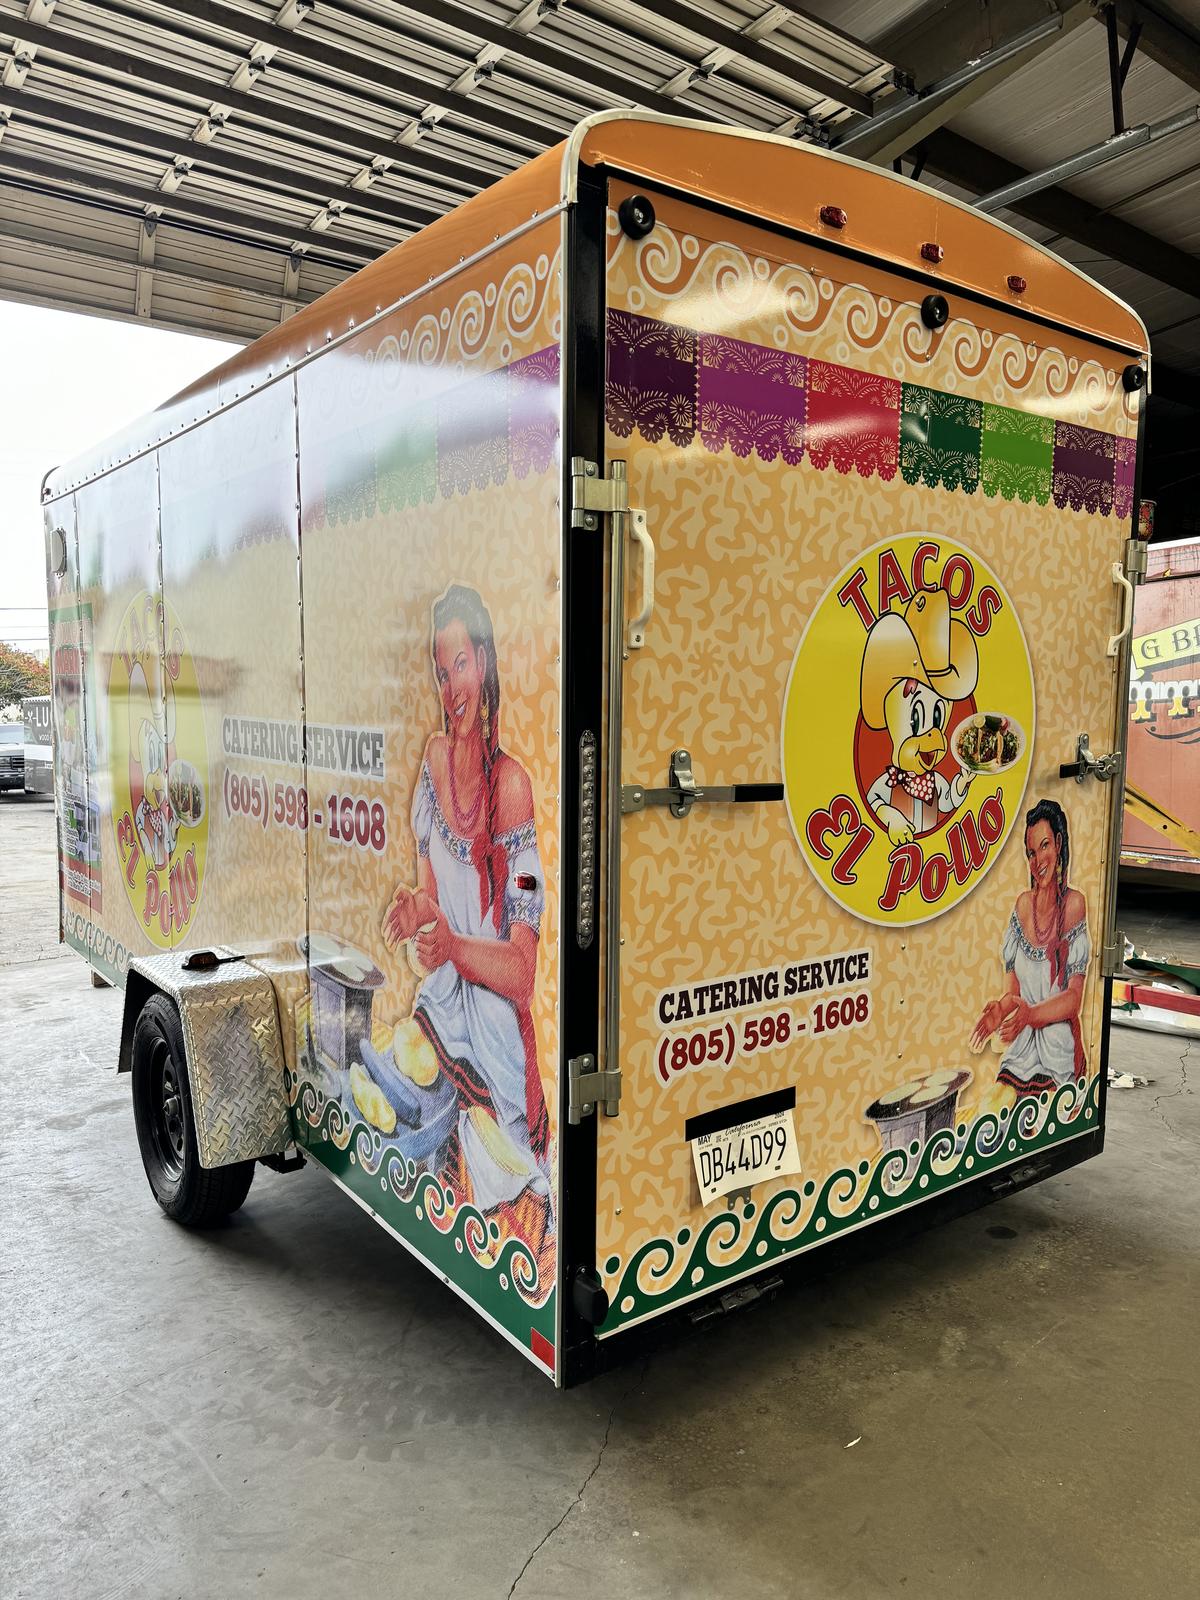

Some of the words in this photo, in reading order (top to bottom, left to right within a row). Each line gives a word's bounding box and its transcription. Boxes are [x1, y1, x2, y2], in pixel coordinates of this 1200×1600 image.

[837, 541, 1003, 638] TACOS
[222, 717, 298, 764] CATERING
[303, 725, 385, 778] SERVICE
[223, 767, 269, 830] (805)
[273, 783, 309, 831] 598
[327, 794, 387, 851] 1608
[806, 794, 875, 886] El
[877, 787, 1005, 912] Pollo
[143, 842, 199, 937] Pollo
[658, 969, 780, 1024] CATERING
[783, 951, 870, 996] SERVICE
[658, 1022, 736, 1082] (805)
[742, 1012, 791, 1052] 598
[812, 993, 869, 1034] 1608
[697, 1133, 712, 1146] MAY
[698, 1126, 788, 1189] DB44D99
